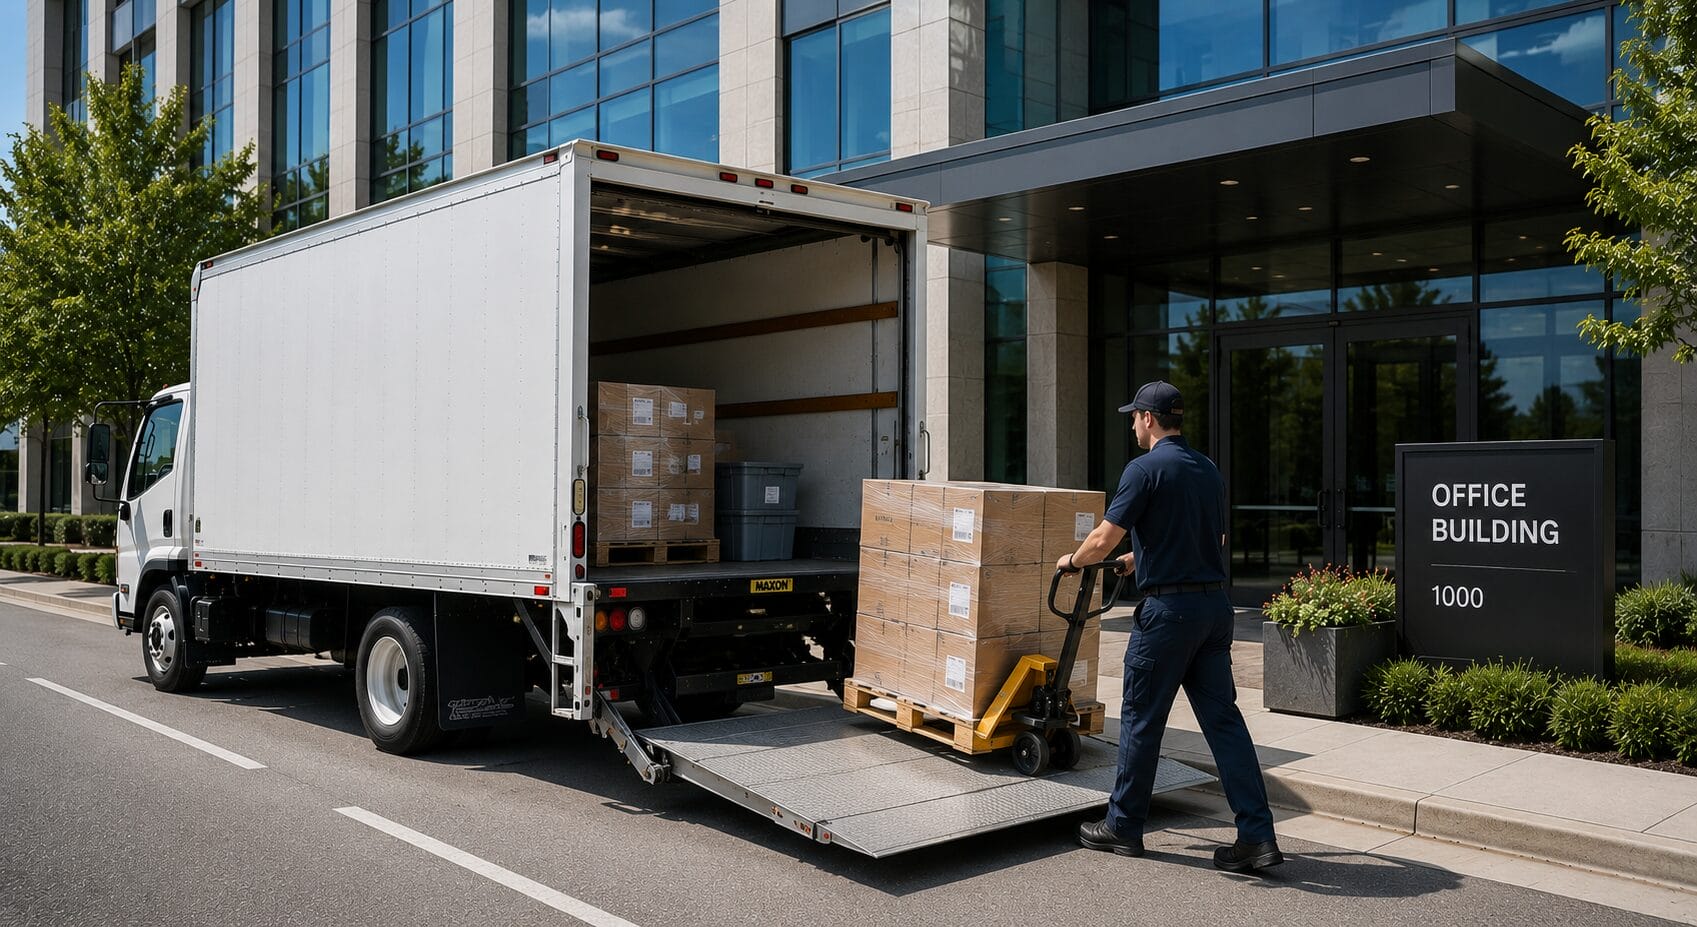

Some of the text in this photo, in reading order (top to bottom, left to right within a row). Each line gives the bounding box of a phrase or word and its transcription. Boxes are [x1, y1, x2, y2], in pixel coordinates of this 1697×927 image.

[1431, 483, 1527, 507] OFFICE
[1432, 518, 1560, 545] BUILDING
[755, 580, 789, 592] MAXON
[1431, 584, 1484, 609] 1000
